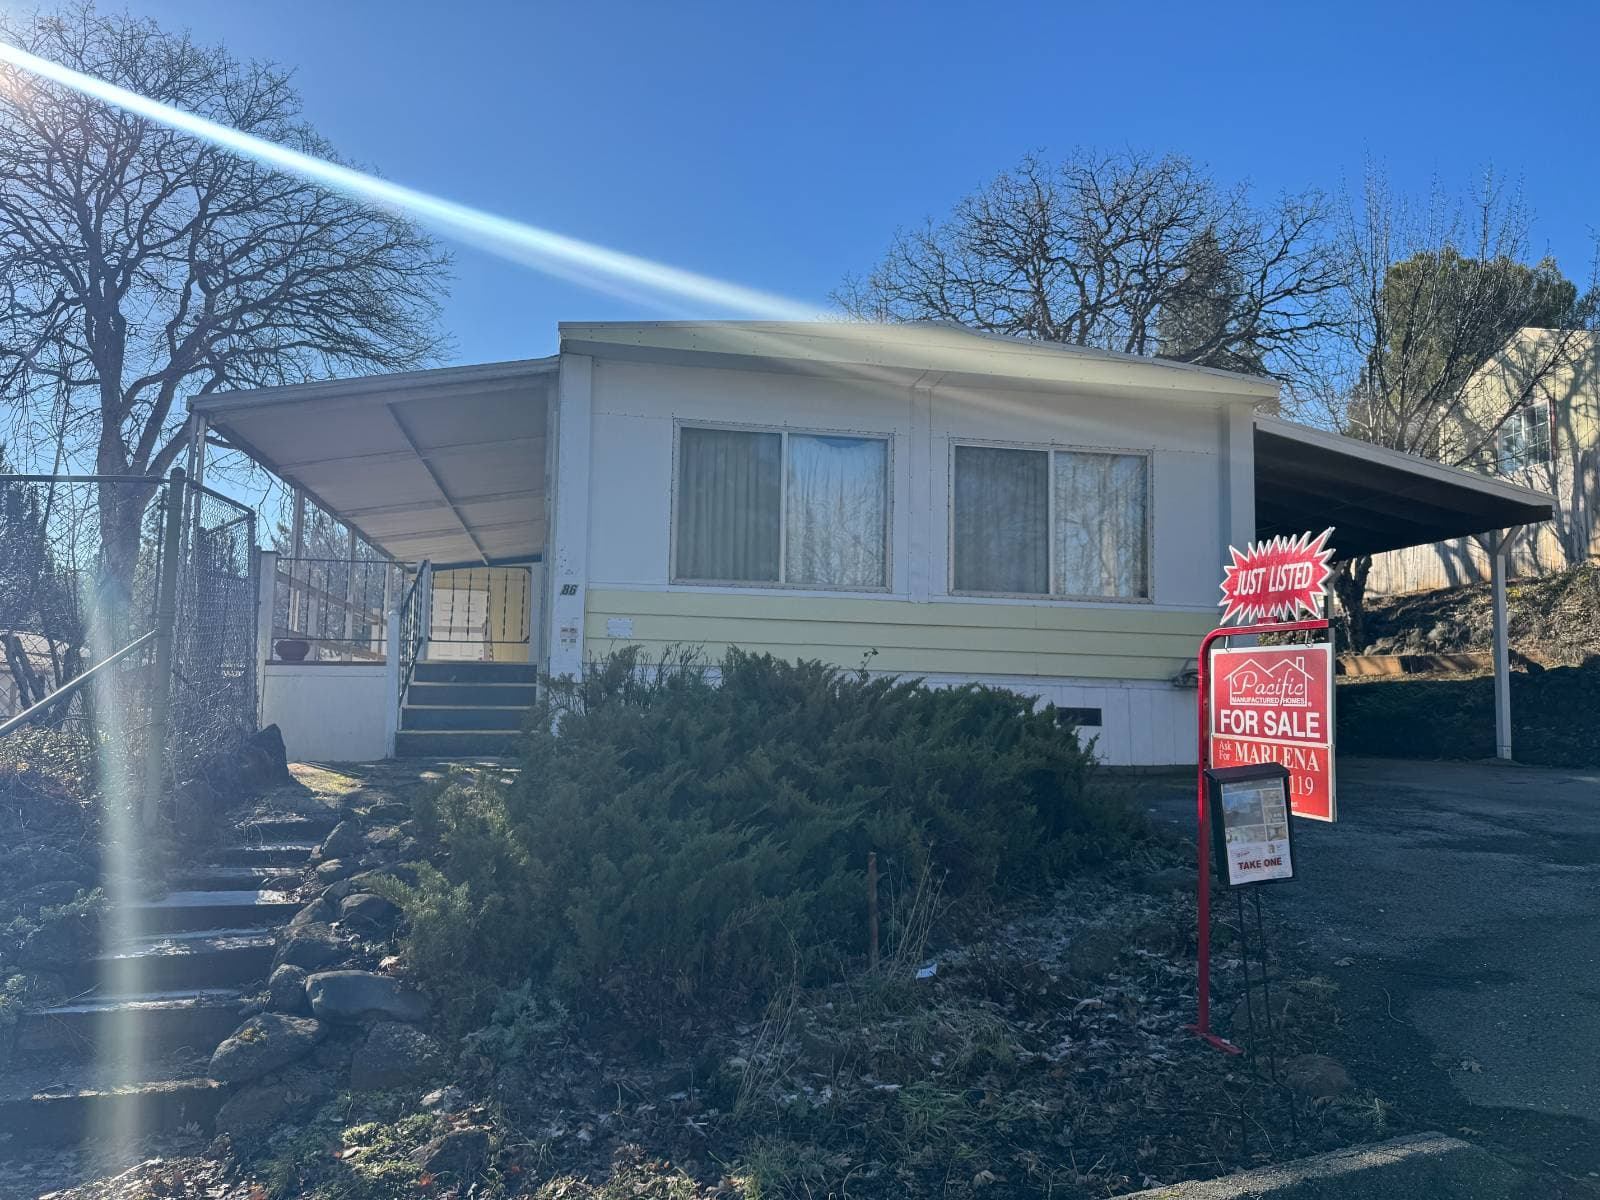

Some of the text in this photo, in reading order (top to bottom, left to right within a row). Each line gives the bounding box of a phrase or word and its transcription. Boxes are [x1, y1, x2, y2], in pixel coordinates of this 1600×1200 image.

[1233, 561, 1313, 596] JUST LISTED
[560, 584, 579, 596] 86
[1232, 668, 1304, 705] Pacific
[1220, 708, 1321, 739] FOR SALE
[1219, 741, 1232, 751] Ask
[1219, 750, 1231, 761] For
[1235, 742, 1320, 772] MARLENA
[1238, 857, 1282, 870] TAKE ONE
